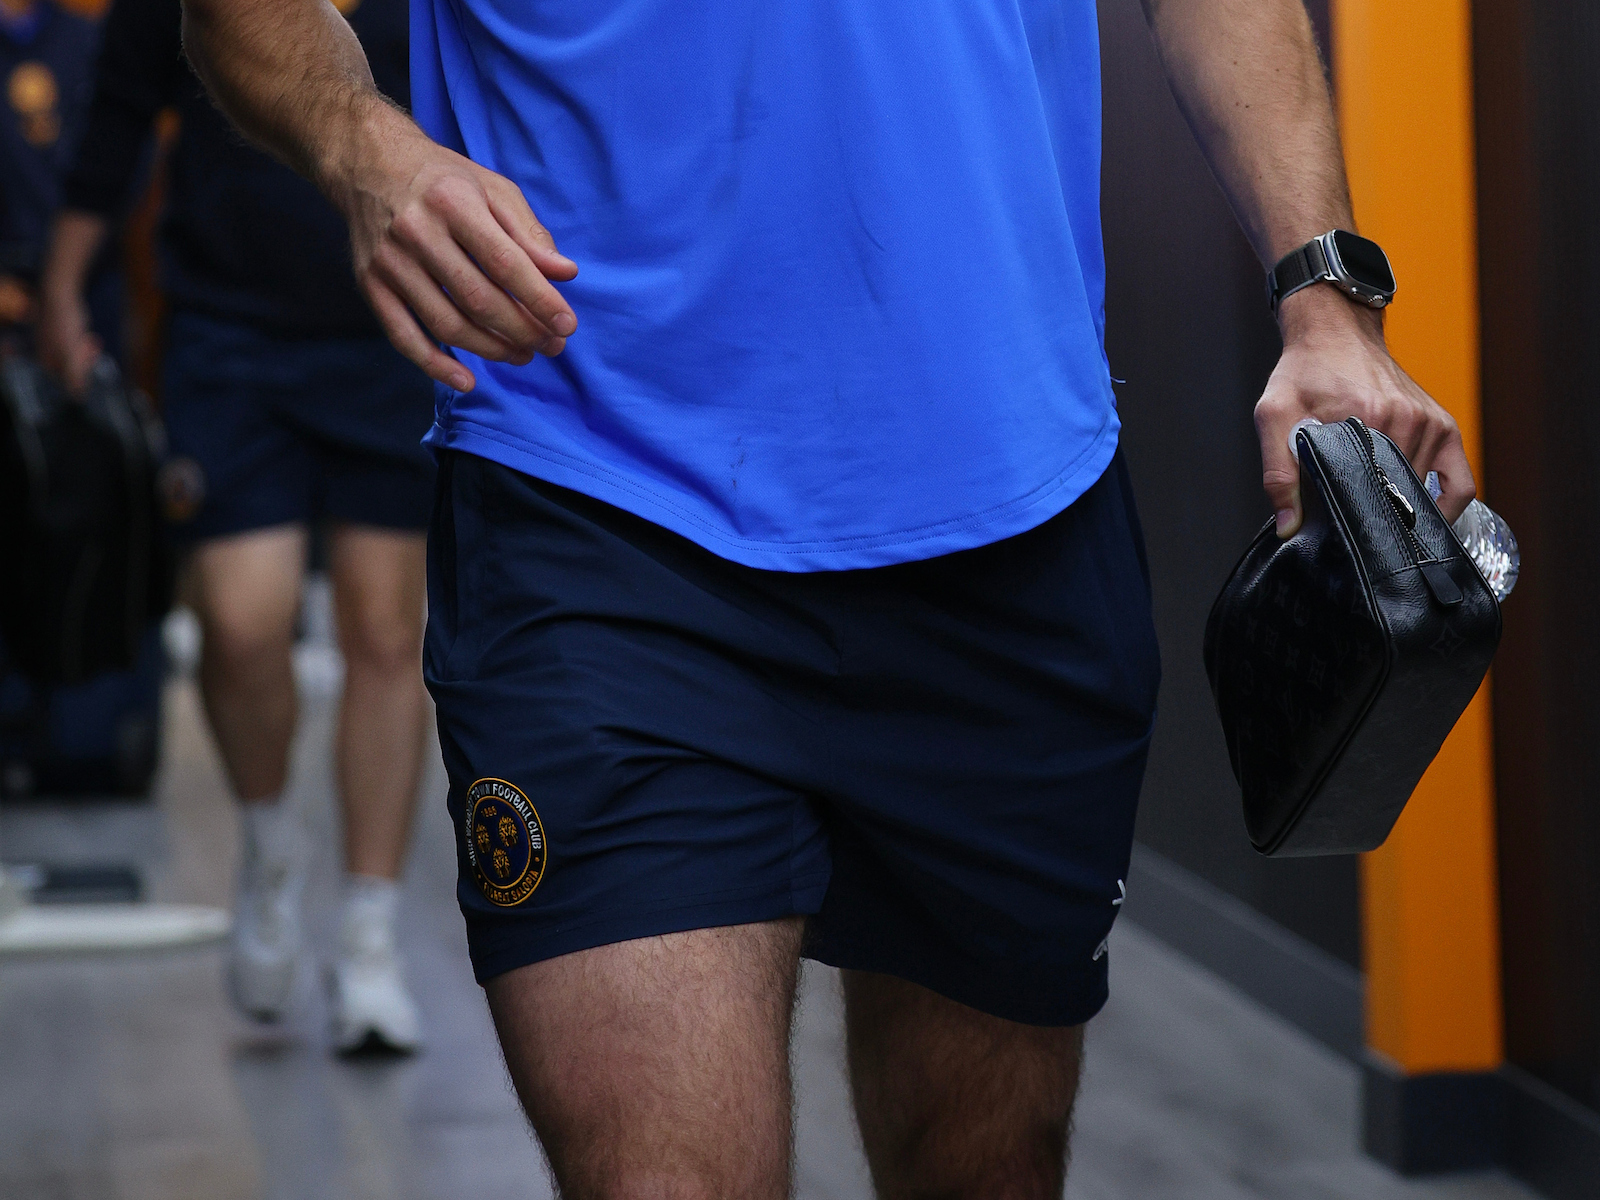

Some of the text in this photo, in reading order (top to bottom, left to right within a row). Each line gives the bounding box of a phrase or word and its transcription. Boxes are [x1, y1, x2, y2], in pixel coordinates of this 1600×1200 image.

[492, 783, 532, 821] FOOTBALL
[527, 821, 542, 850] CLUB
[512, 870, 540, 901] SALOPIA
